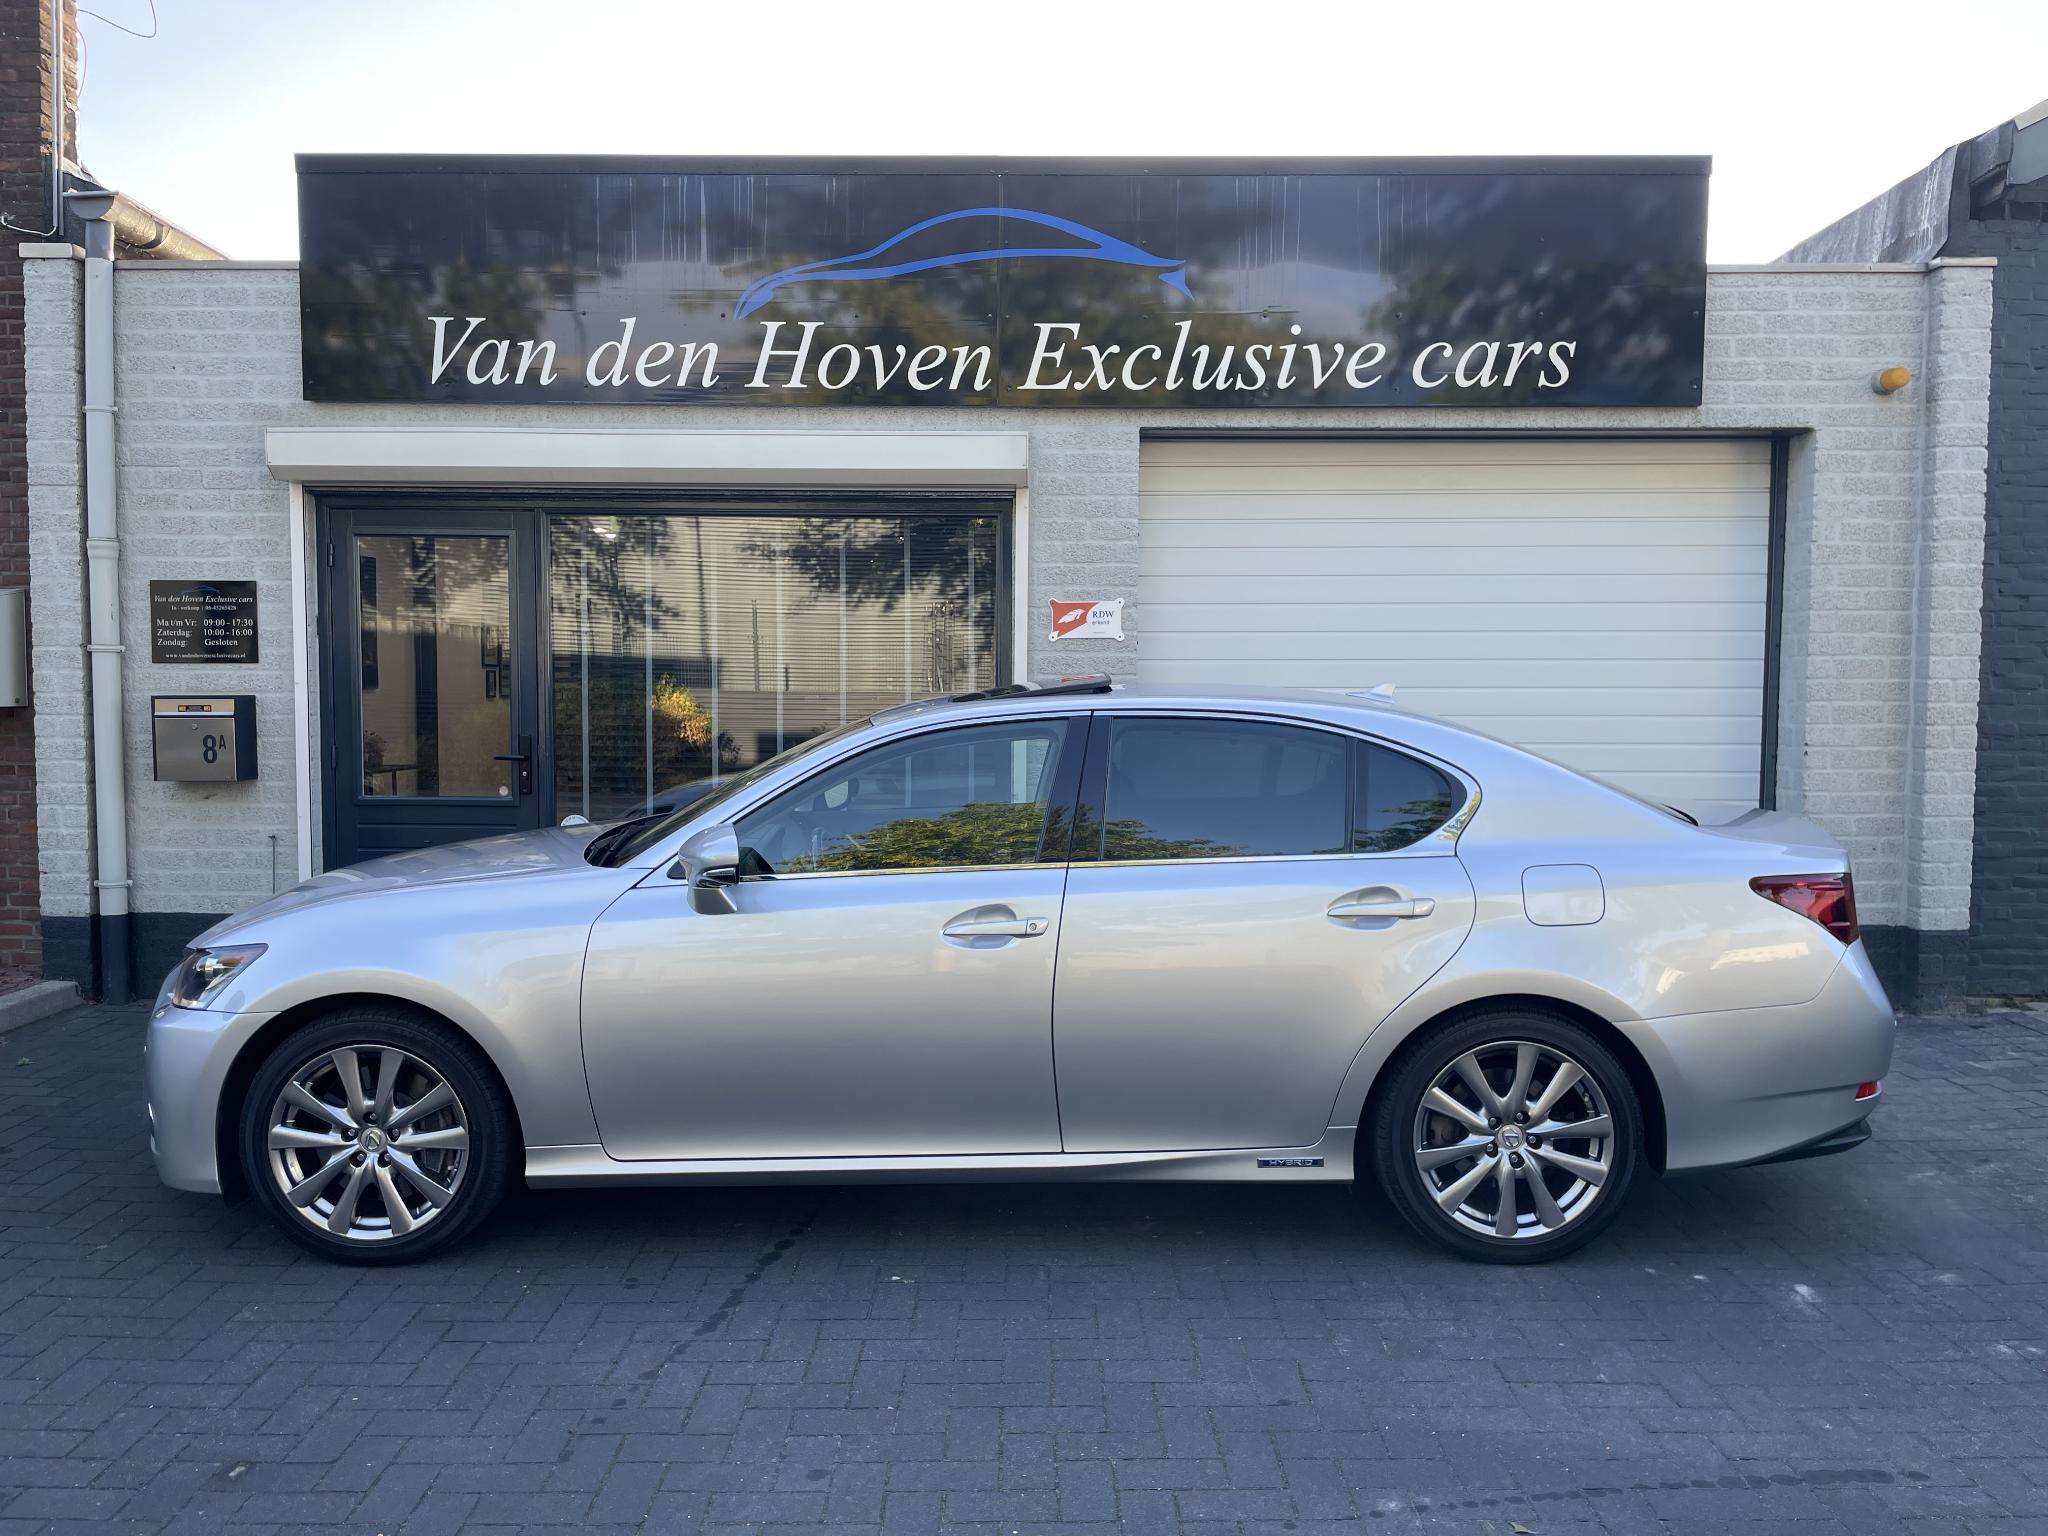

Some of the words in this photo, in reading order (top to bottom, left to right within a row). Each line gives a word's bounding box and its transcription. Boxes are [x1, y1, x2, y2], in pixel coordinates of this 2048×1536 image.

[427, 316, 558, 386] Van
[586, 316, 720, 388] den
[744, 321, 992, 391] Hoven
[1017, 319, 1386, 391] Exclusive
[1412, 341, 1577, 388] cars
[154, 595, 167, 603] Van
[168, 595, 180, 603] den
[181, 595, 204, 603] Hoven
[205, 595, 238, 603] Exclusive
[1092, 610, 1114, 618] RDW
[156, 618, 169, 627] Ma
[170, 618, 183, 627] t/m
[184, 618, 198, 627] Vr:
[203, 618, 226, 627] 09:00
[231, 618, 254, 627] 17:30
[156, 628, 193, 638] Zaterdag:
[203, 628, 225, 636] 10:00
[231, 628, 253, 636] 16:00
[157, 638, 188, 648] Zondag:
[204, 638, 239, 646] Gesloten
